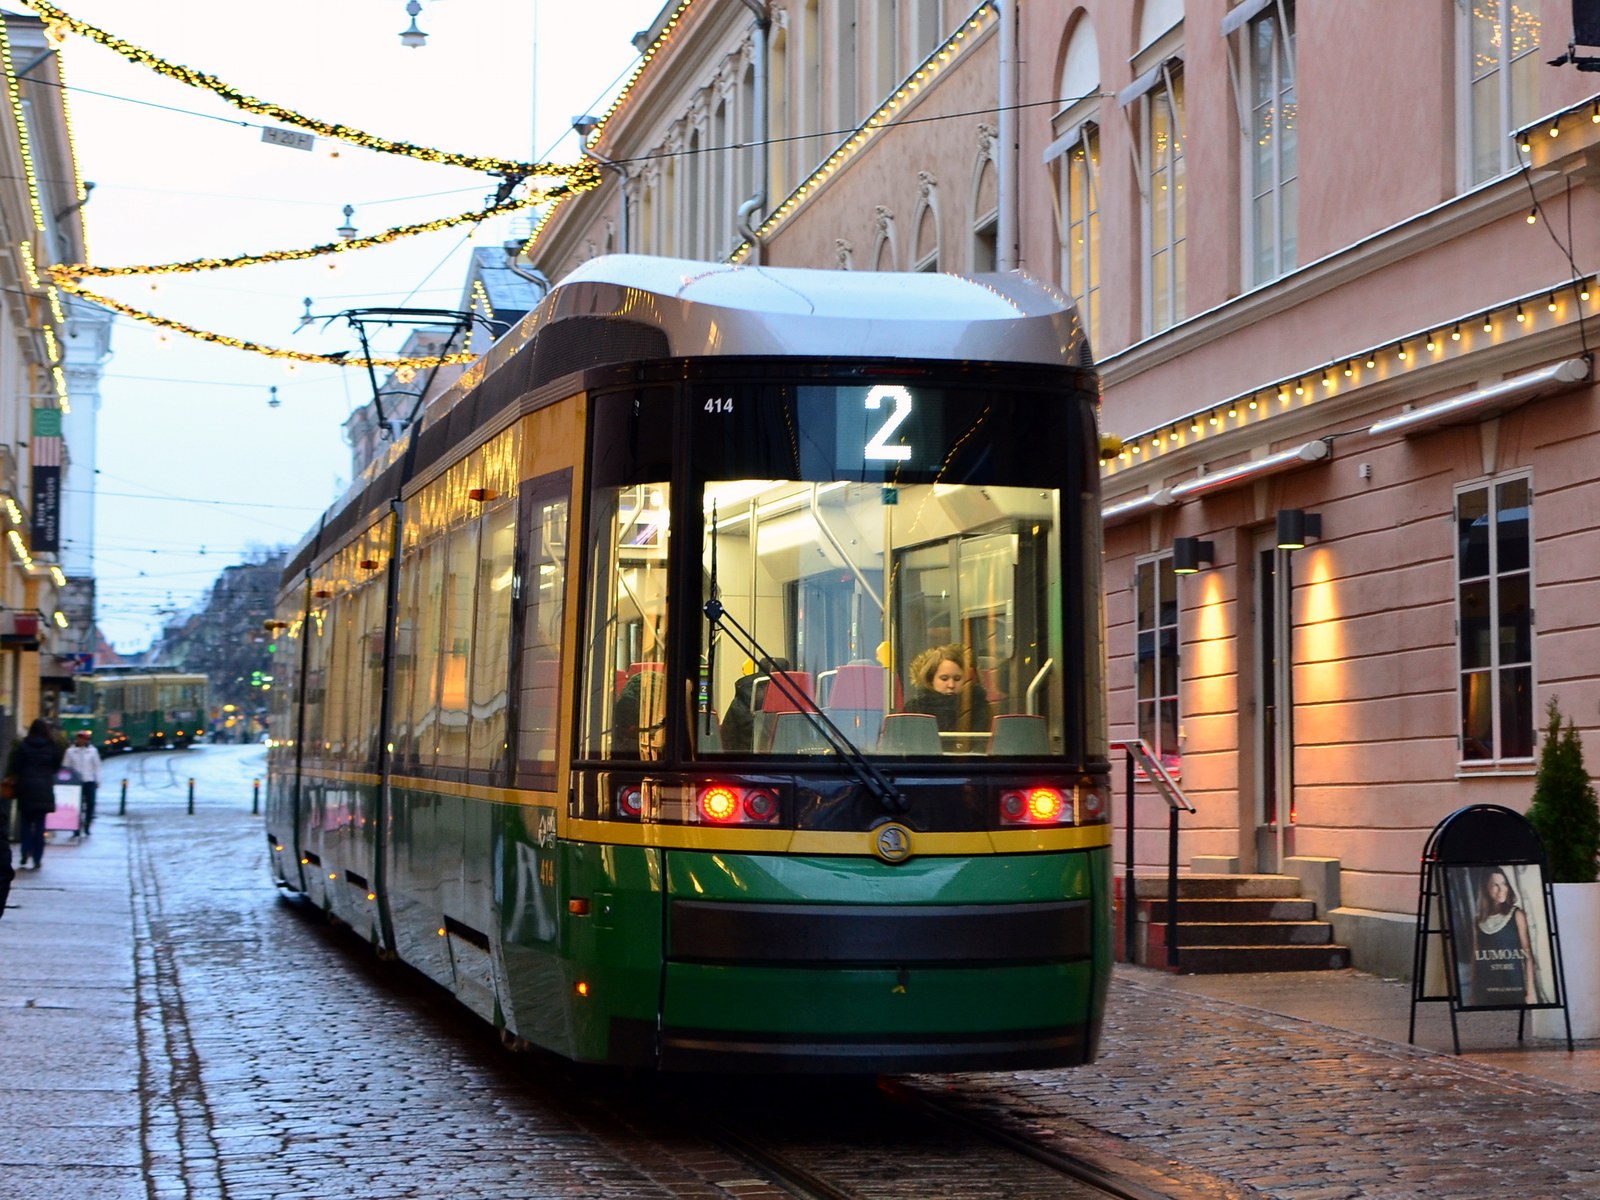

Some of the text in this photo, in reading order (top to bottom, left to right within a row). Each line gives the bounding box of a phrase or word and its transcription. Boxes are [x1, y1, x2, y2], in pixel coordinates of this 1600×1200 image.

[704, 398, 734, 413] 414
[864, 385, 912, 460] 2
[540, 859, 554, 887] 414
